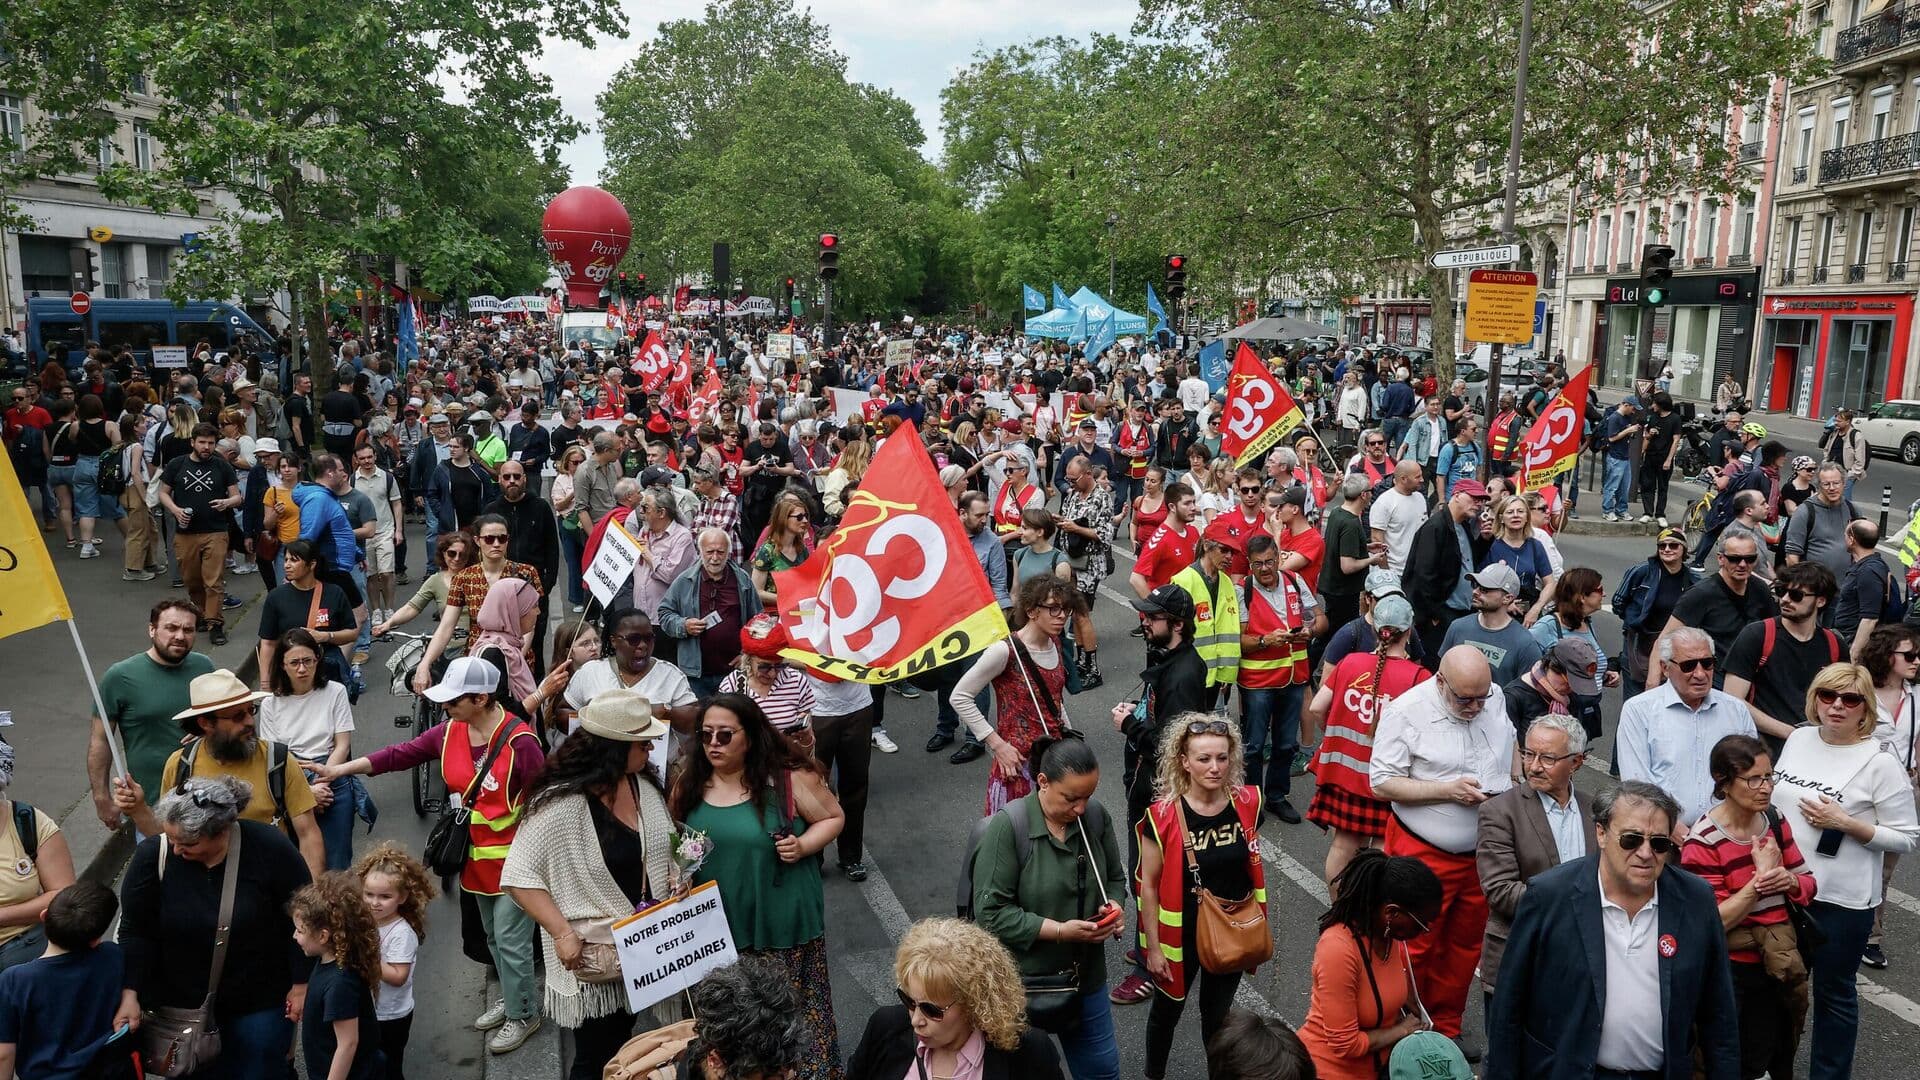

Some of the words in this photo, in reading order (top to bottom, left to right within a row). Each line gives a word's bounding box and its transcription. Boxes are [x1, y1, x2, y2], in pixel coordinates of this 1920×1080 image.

[590, 240, 622, 255] Paris
[1452, 250, 1508, 263] RÉPUBLIQUE
[584, 265, 613, 283] cgt
[1482, 273, 1527, 283] ATTENTION
[1344, 688, 1393, 724] cgt
[623, 923, 659, 948] NOTRE
[661, 898, 718, 931] PROBLEME
[655, 938, 679, 955] C'EST
[682, 930, 695, 944] LES
[633, 938, 727, 990] MILLIARDAIRES
